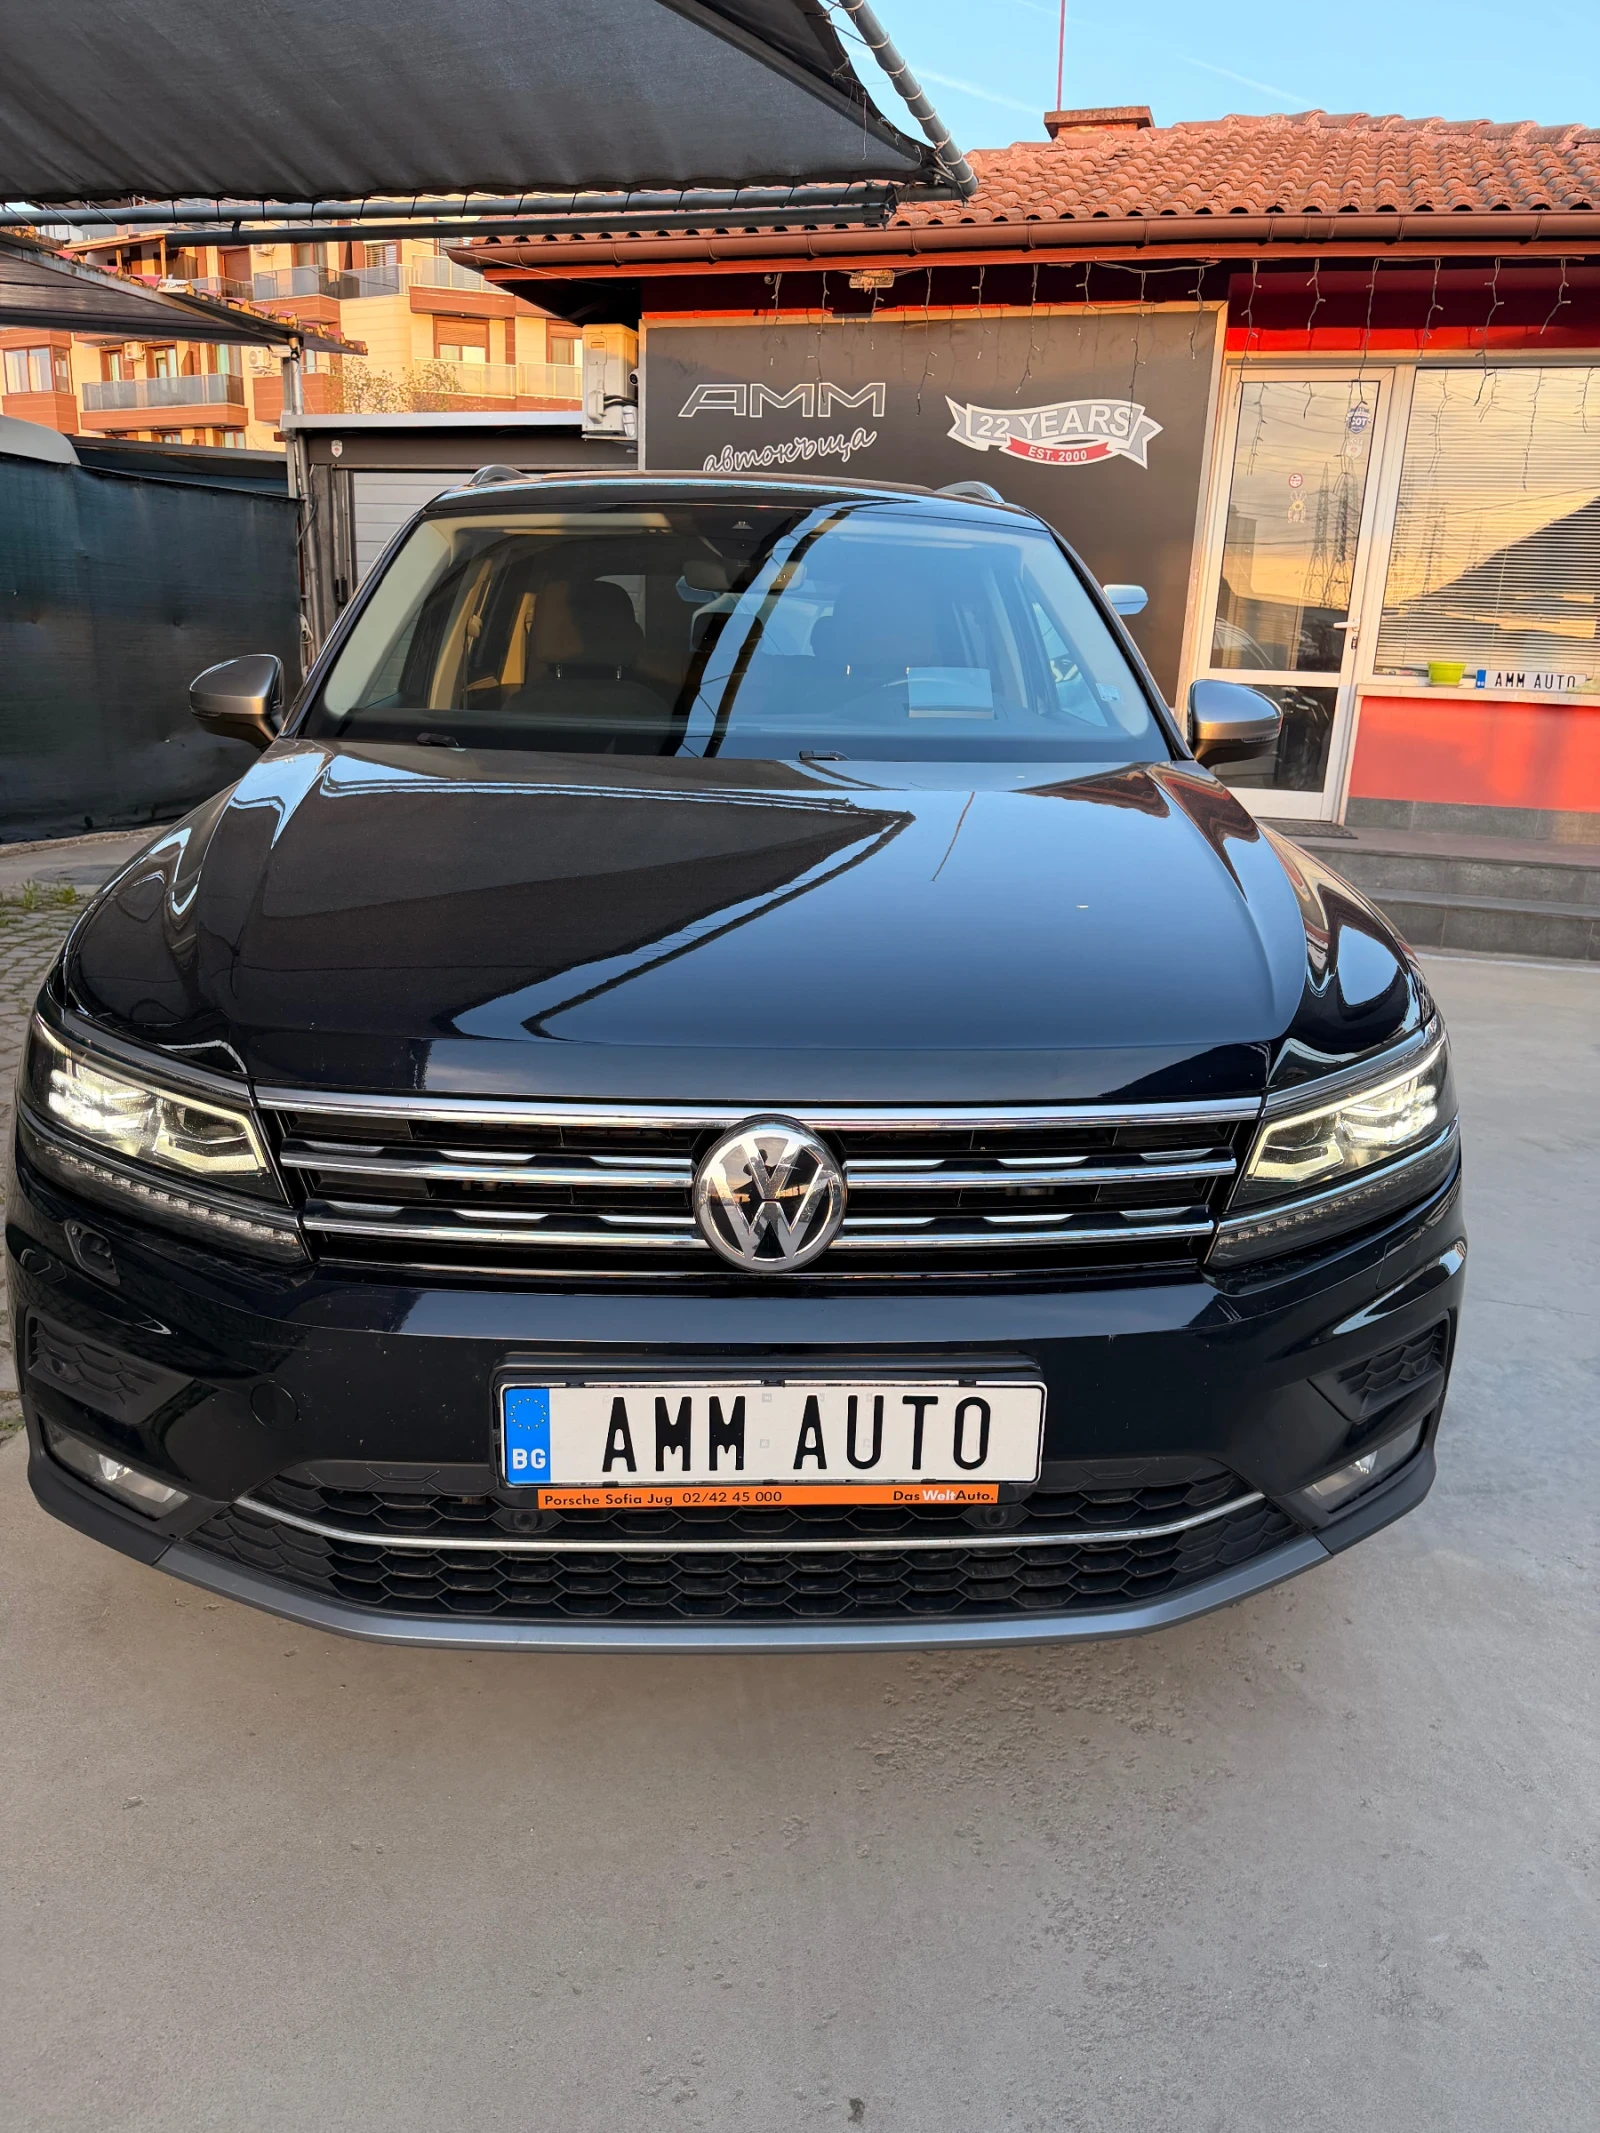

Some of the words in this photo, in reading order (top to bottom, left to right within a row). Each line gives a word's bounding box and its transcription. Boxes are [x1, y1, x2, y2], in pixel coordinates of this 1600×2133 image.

[678, 382, 886, 418] AMM
[976, 415, 1010, 439] 22
[1018, 404, 1135, 440] YEARS
[1027, 446, 1055, 461] EST.
[1058, 450, 1087, 462] 2000
[1495, 672, 1525, 688] AMM
[602, 1396, 746, 1472] AMM
[793, 1395, 991, 1470] AUTO
[512, 1448, 546, 1470] BG
[544, 1494, 600, 1506] Porsche
[605, 1494, 642, 1505] Sofia
[647, 1493, 673, 1506] Jug
[682, 1492, 728, 1504] 02/42
[732, 1491, 750, 1503] 45
[755, 1491, 782, 1503] 000
[893, 1490, 920, 1501] Das
